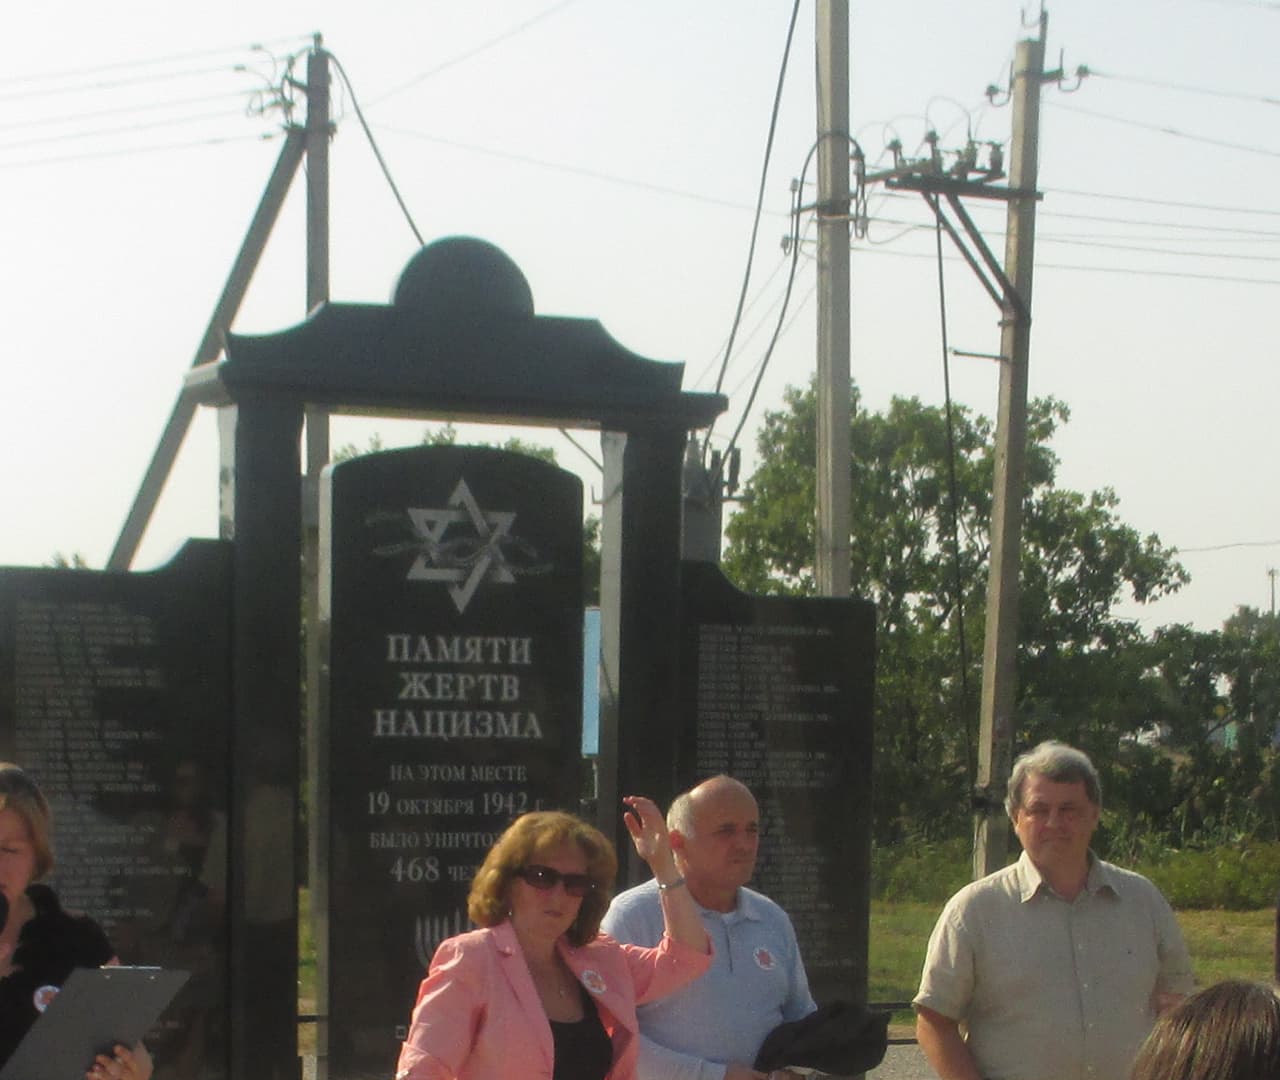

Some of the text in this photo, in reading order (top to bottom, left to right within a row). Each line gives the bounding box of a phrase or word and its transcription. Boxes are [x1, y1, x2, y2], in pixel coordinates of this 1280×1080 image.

[387, 634, 532, 664] ПАМЯТИ
[398, 672, 520, 701] ЖЕРТВ
[373, 709, 543, 741] НАЦИЗМА
[390, 765, 528, 782] НА ЭТОМ МЕСТЕ
[368, 791, 390, 815] 19
[397, 799, 474, 815] ОКТЯБРЯ
[483, 792, 528, 815] 1942
[370, 831, 499, 849] БЫЛО УНИЧТО
[390, 857, 440, 882] 468
